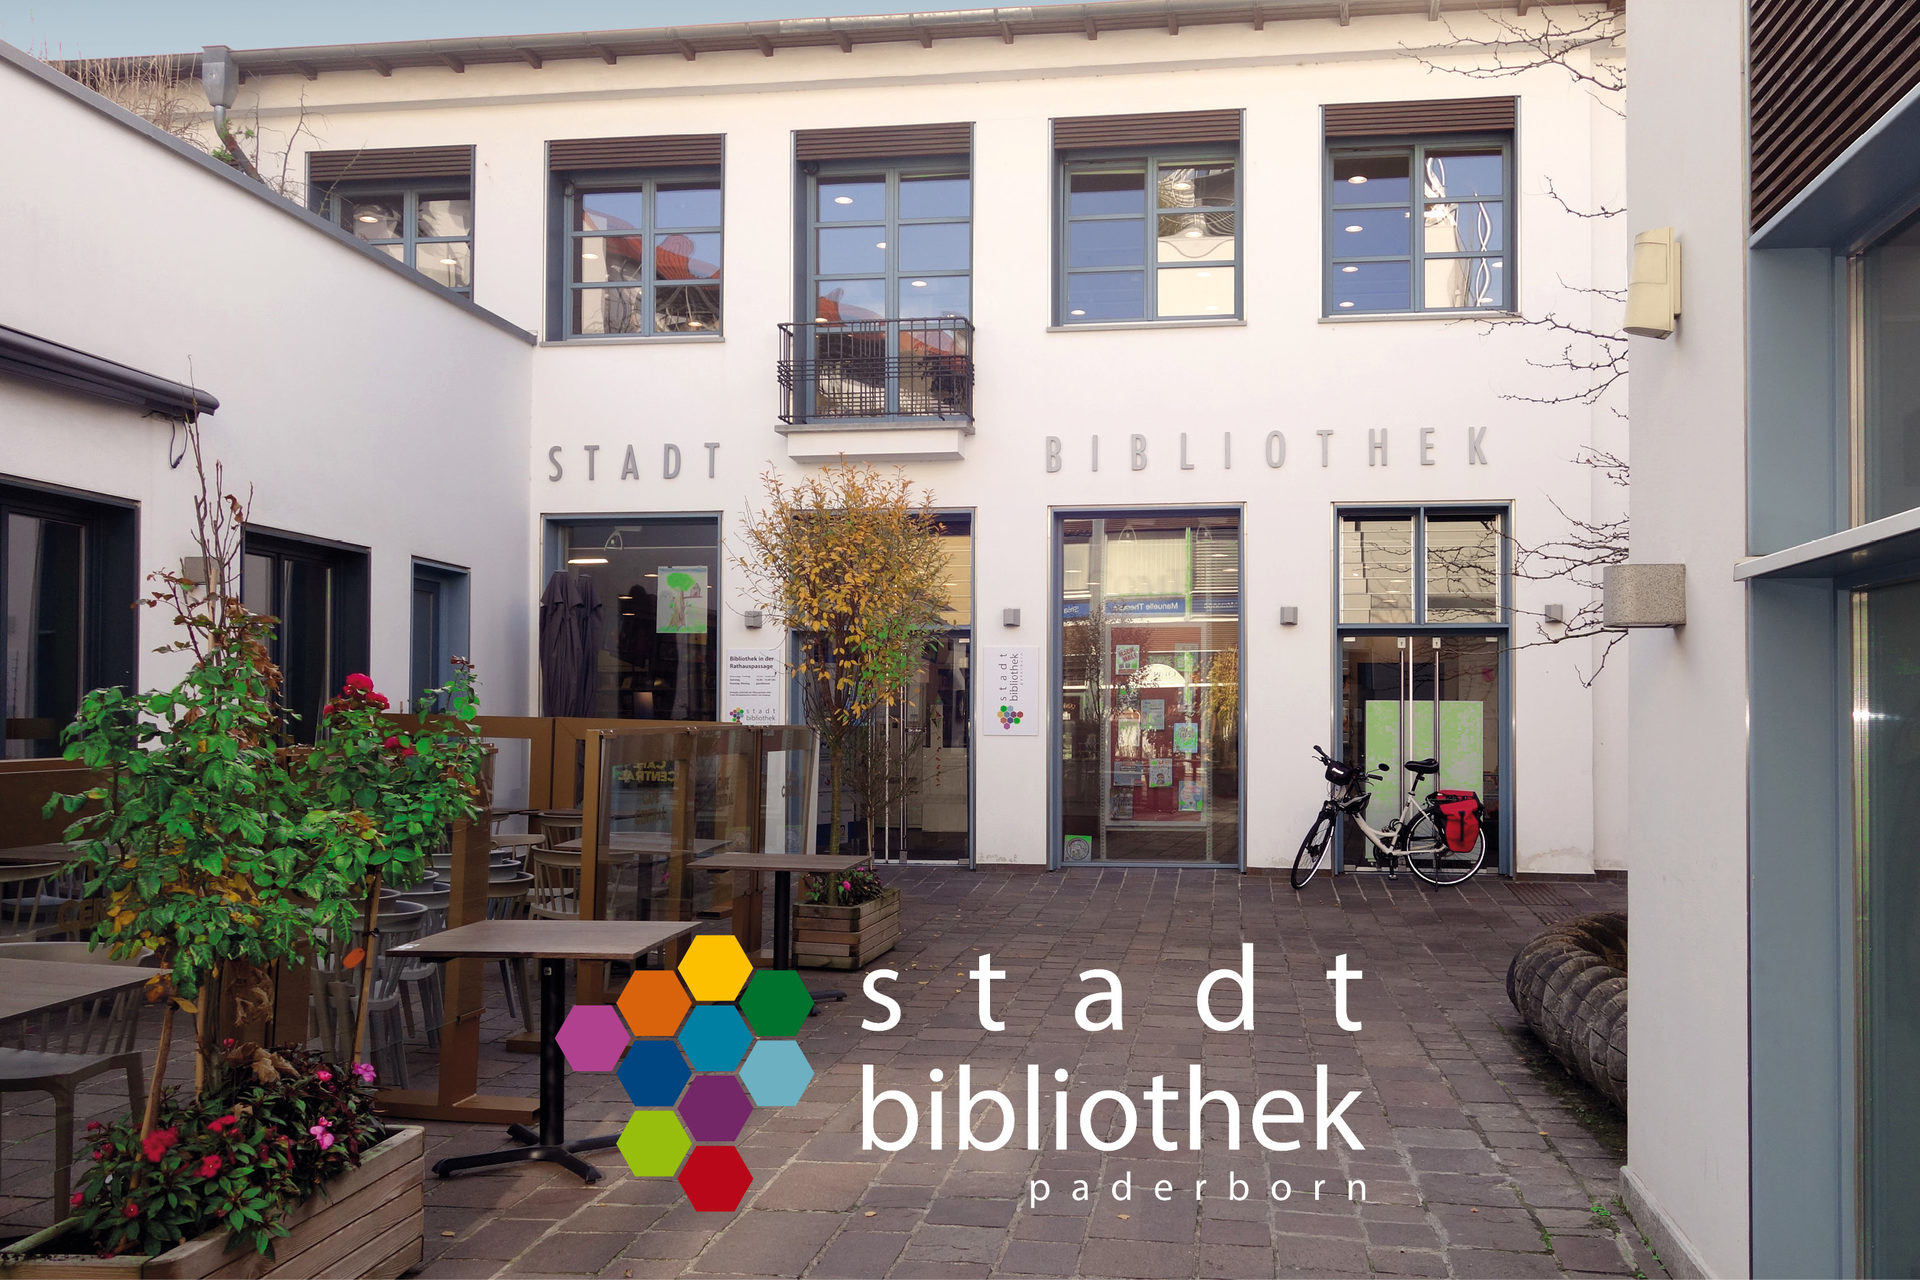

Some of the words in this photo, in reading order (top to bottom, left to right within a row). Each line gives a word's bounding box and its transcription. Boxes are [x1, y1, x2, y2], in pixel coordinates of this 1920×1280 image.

[548, 442, 720, 482] STADT
[1045, 426, 1488, 473] BIBLIOTHEK
[998, 653, 1008, 702] stadt
[1009, 653, 1019, 702] bibliothek
